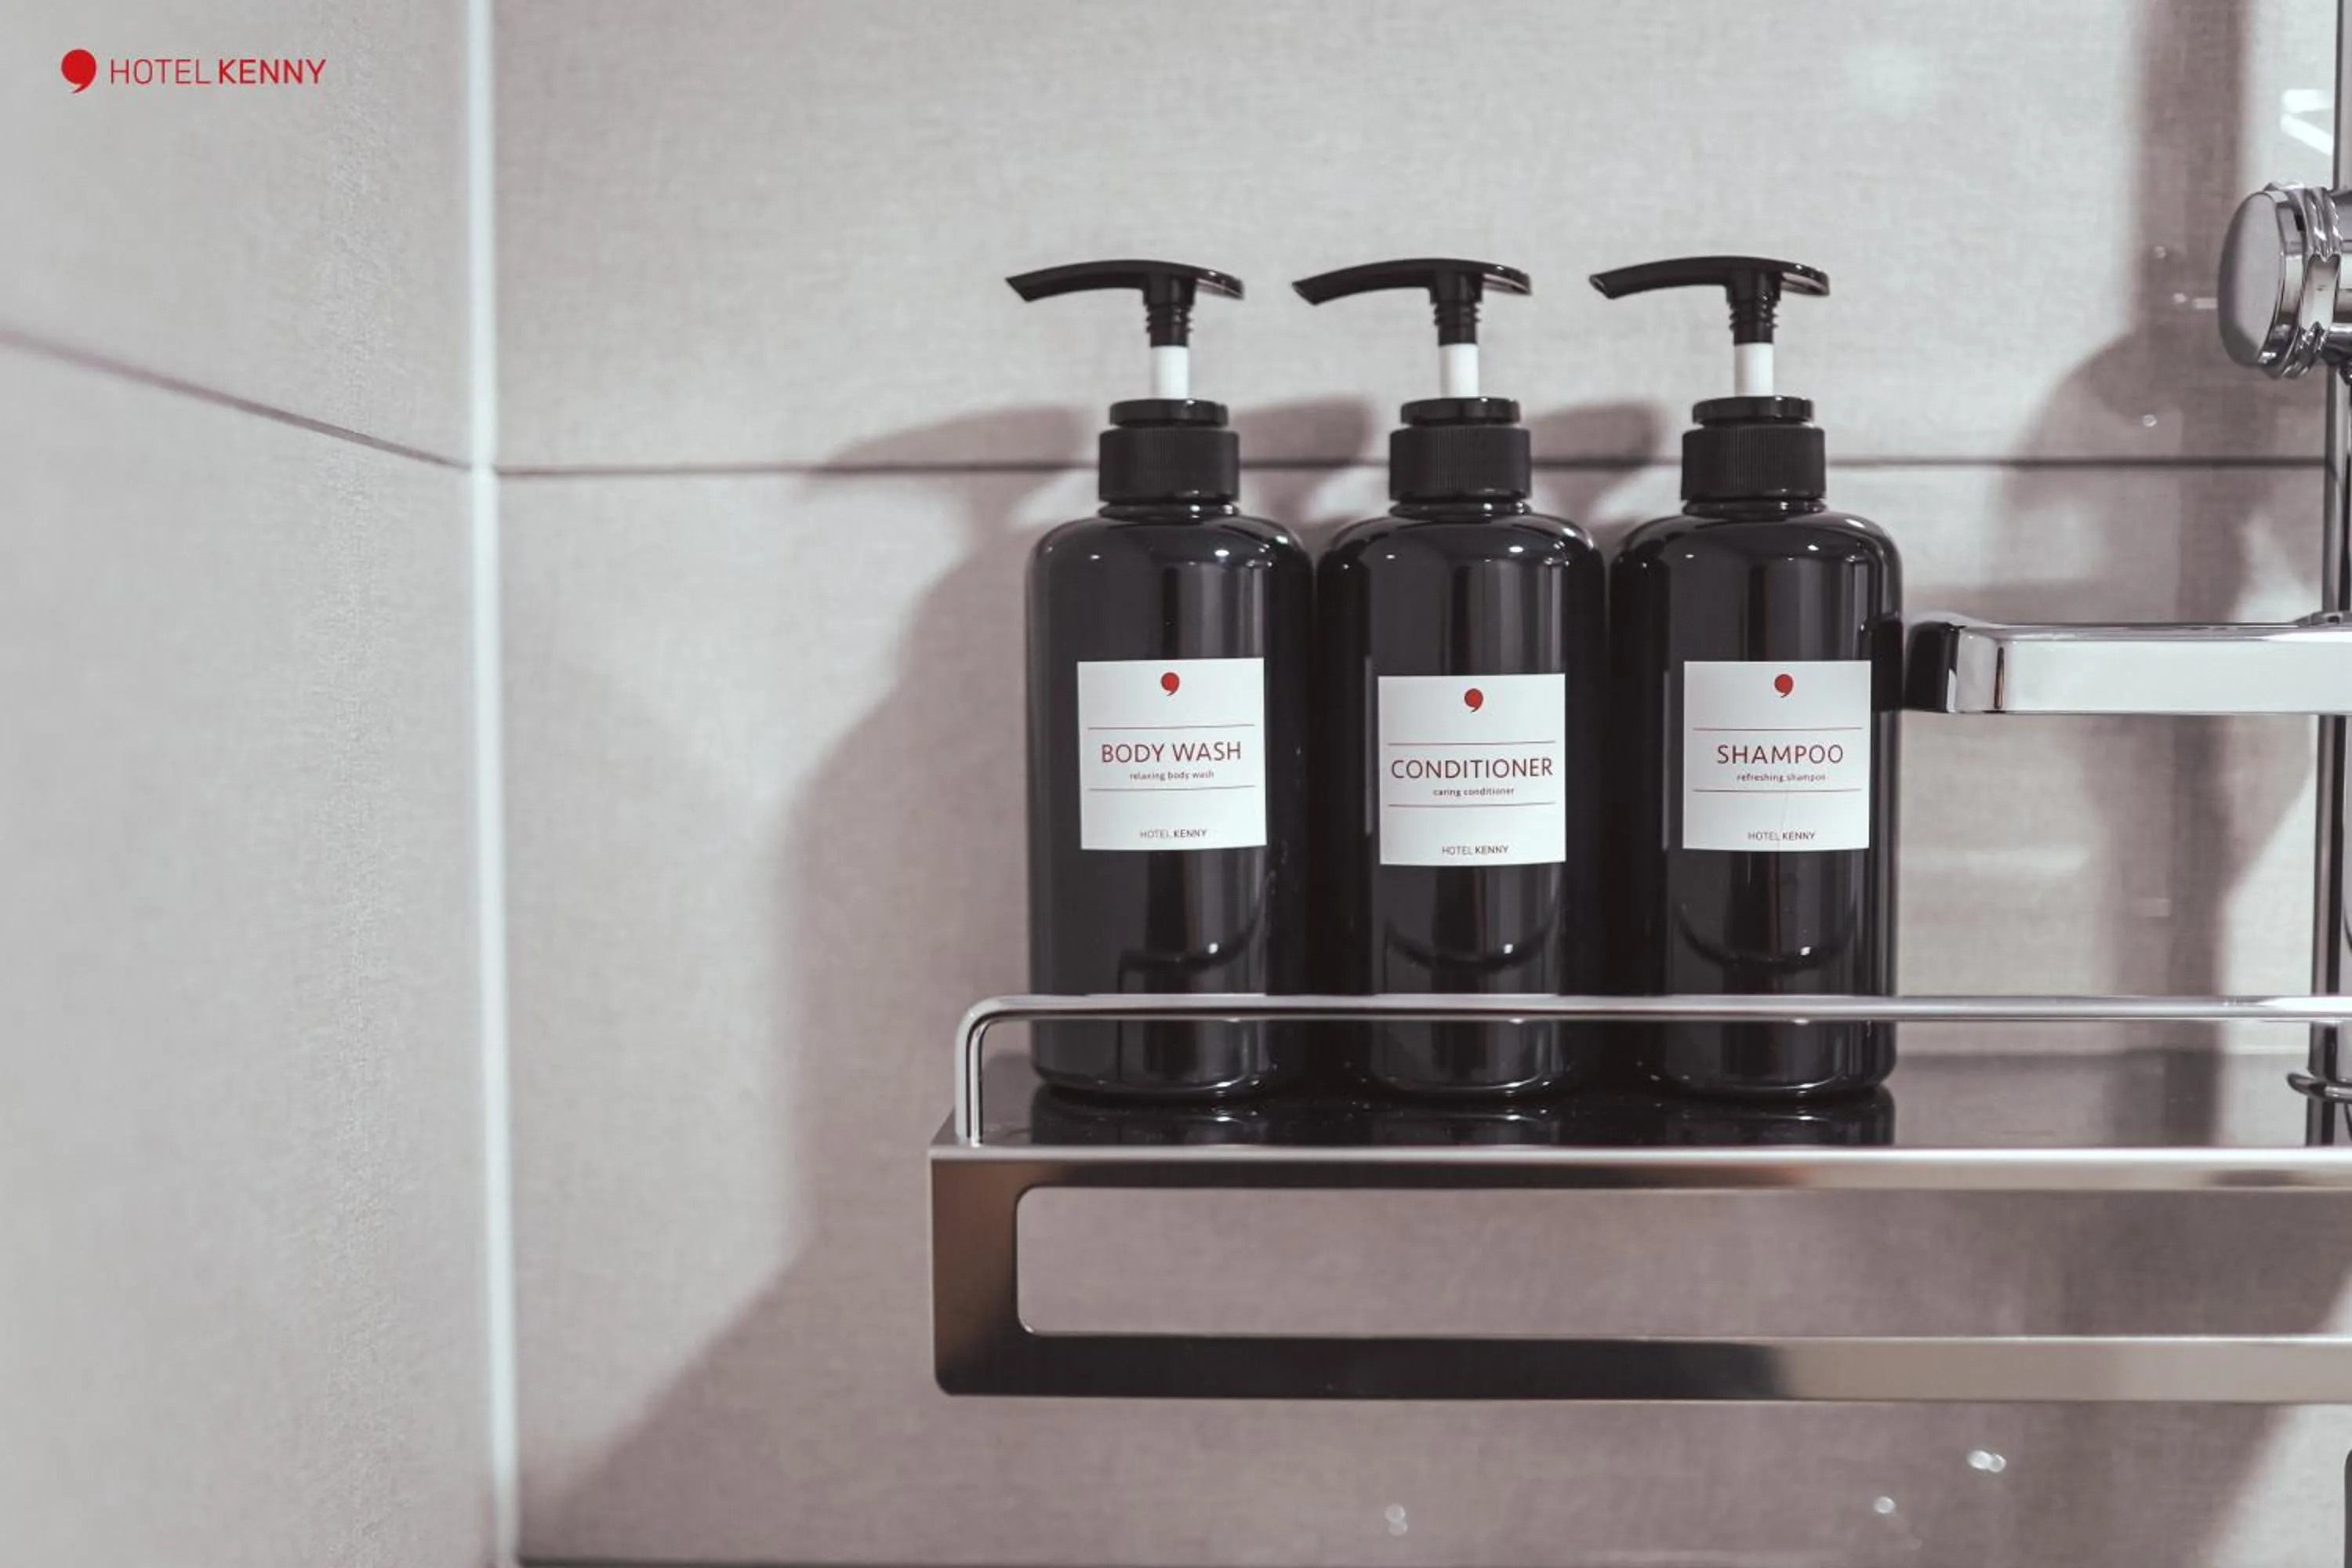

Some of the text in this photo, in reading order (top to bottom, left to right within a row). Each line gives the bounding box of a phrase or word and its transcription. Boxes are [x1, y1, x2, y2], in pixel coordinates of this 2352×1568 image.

[1102, 742, 1241, 764] BODY WASH
[1717, 744, 1843, 764] SHAMPOO
[1391, 758, 1553, 779] CONDITIONER
[1130, 771, 1214, 782] relaxing body wash
[1737, 772, 1784, 782] refreshing
[1433, 787, 1514, 797] caring conditioner
[1140, 829, 1207, 839] HOTEL KENNY
[1748, 831, 1816, 840] HOTEL KENNY
[1442, 845, 1509, 855] HOTEL KENNY
